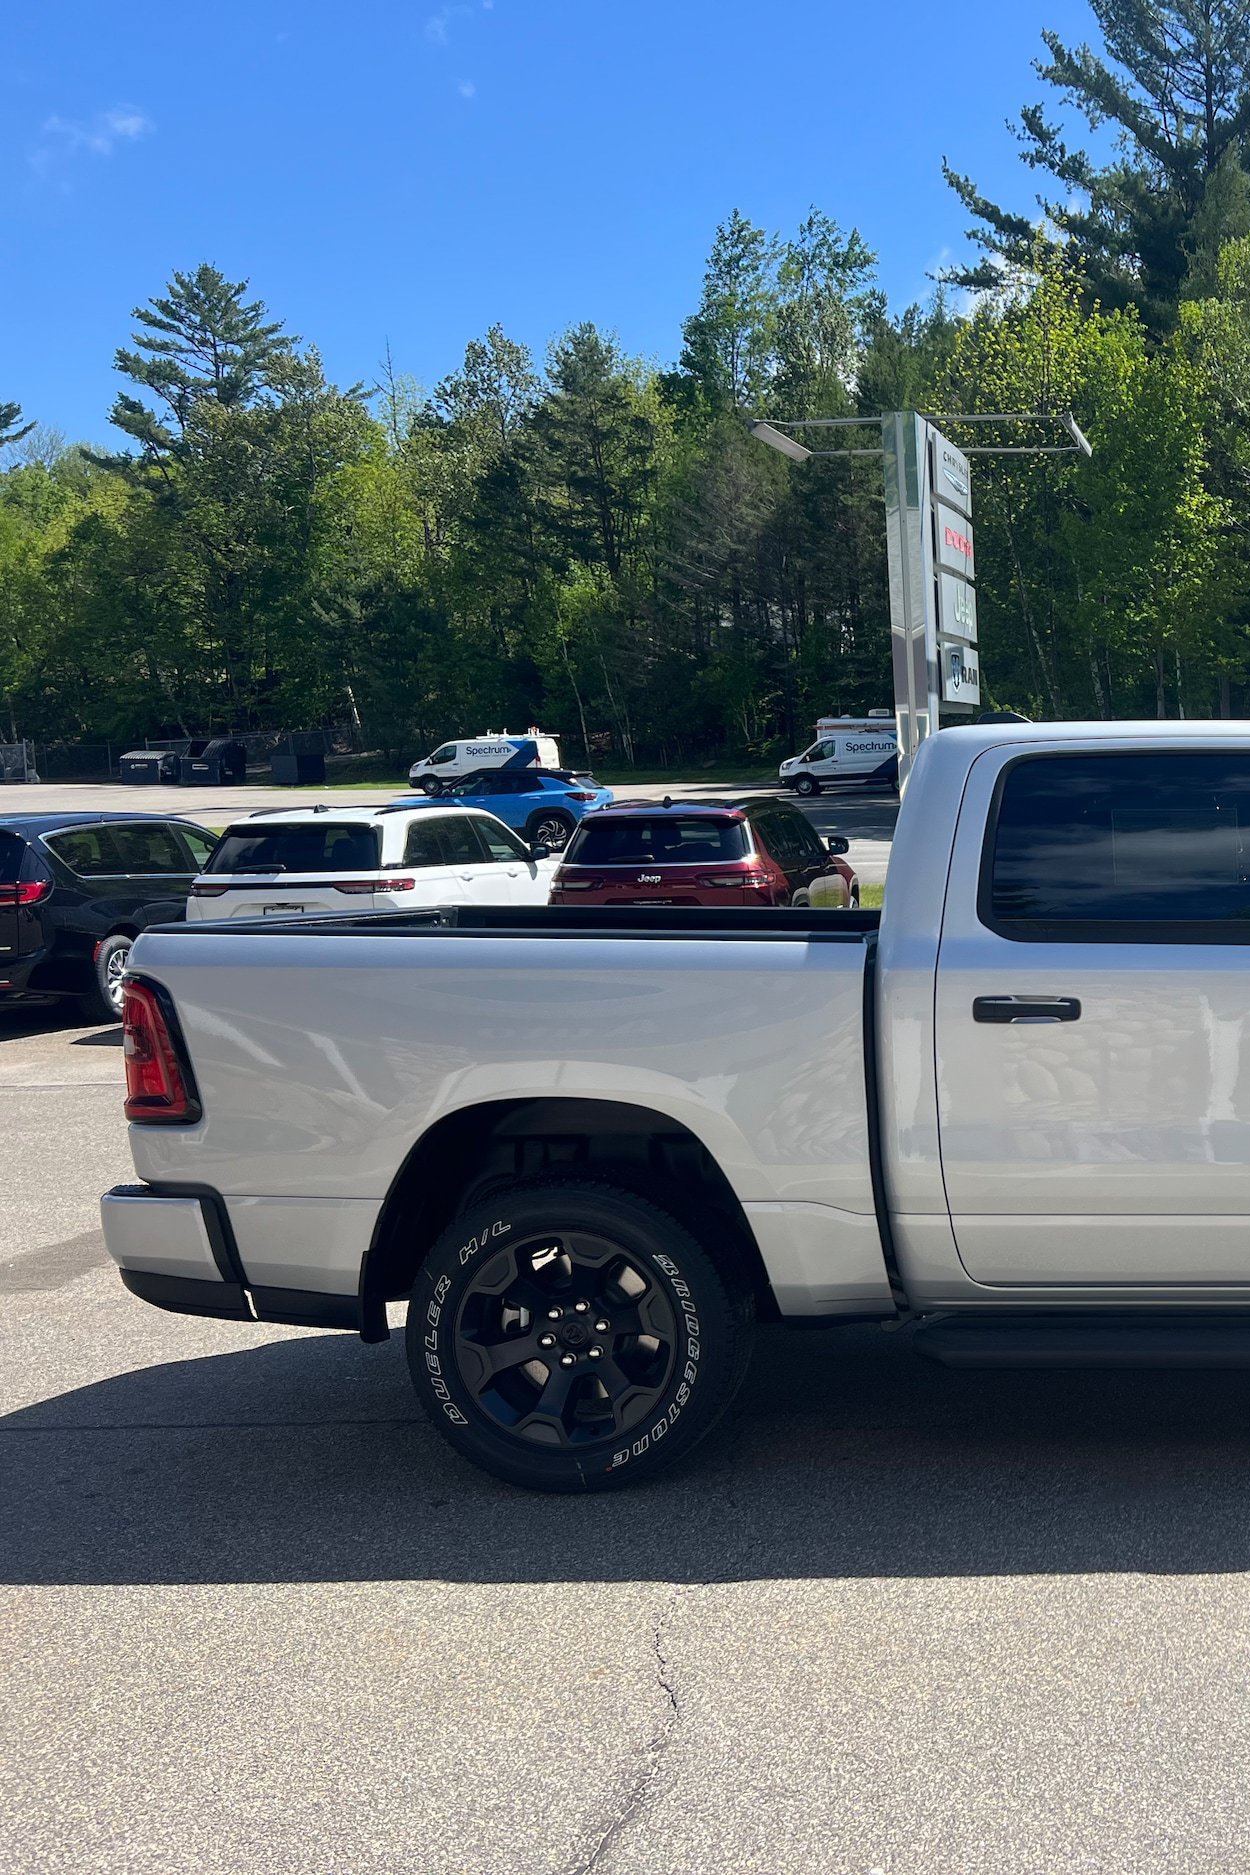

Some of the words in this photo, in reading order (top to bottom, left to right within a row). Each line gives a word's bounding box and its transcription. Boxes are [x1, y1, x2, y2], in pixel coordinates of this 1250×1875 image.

[954, 584, 974, 633] Jeep
[961, 665, 978, 686] RAM
[466, 746, 509, 757] Spectrum
[845, 742, 895, 753] Spectrum
[637, 873, 661, 884] Jeep
[424, 1274, 468, 1424] DUELER
[459, 1221, 511, 1265] H/L
[612, 1254, 700, 1467] BRIDGESTONE
